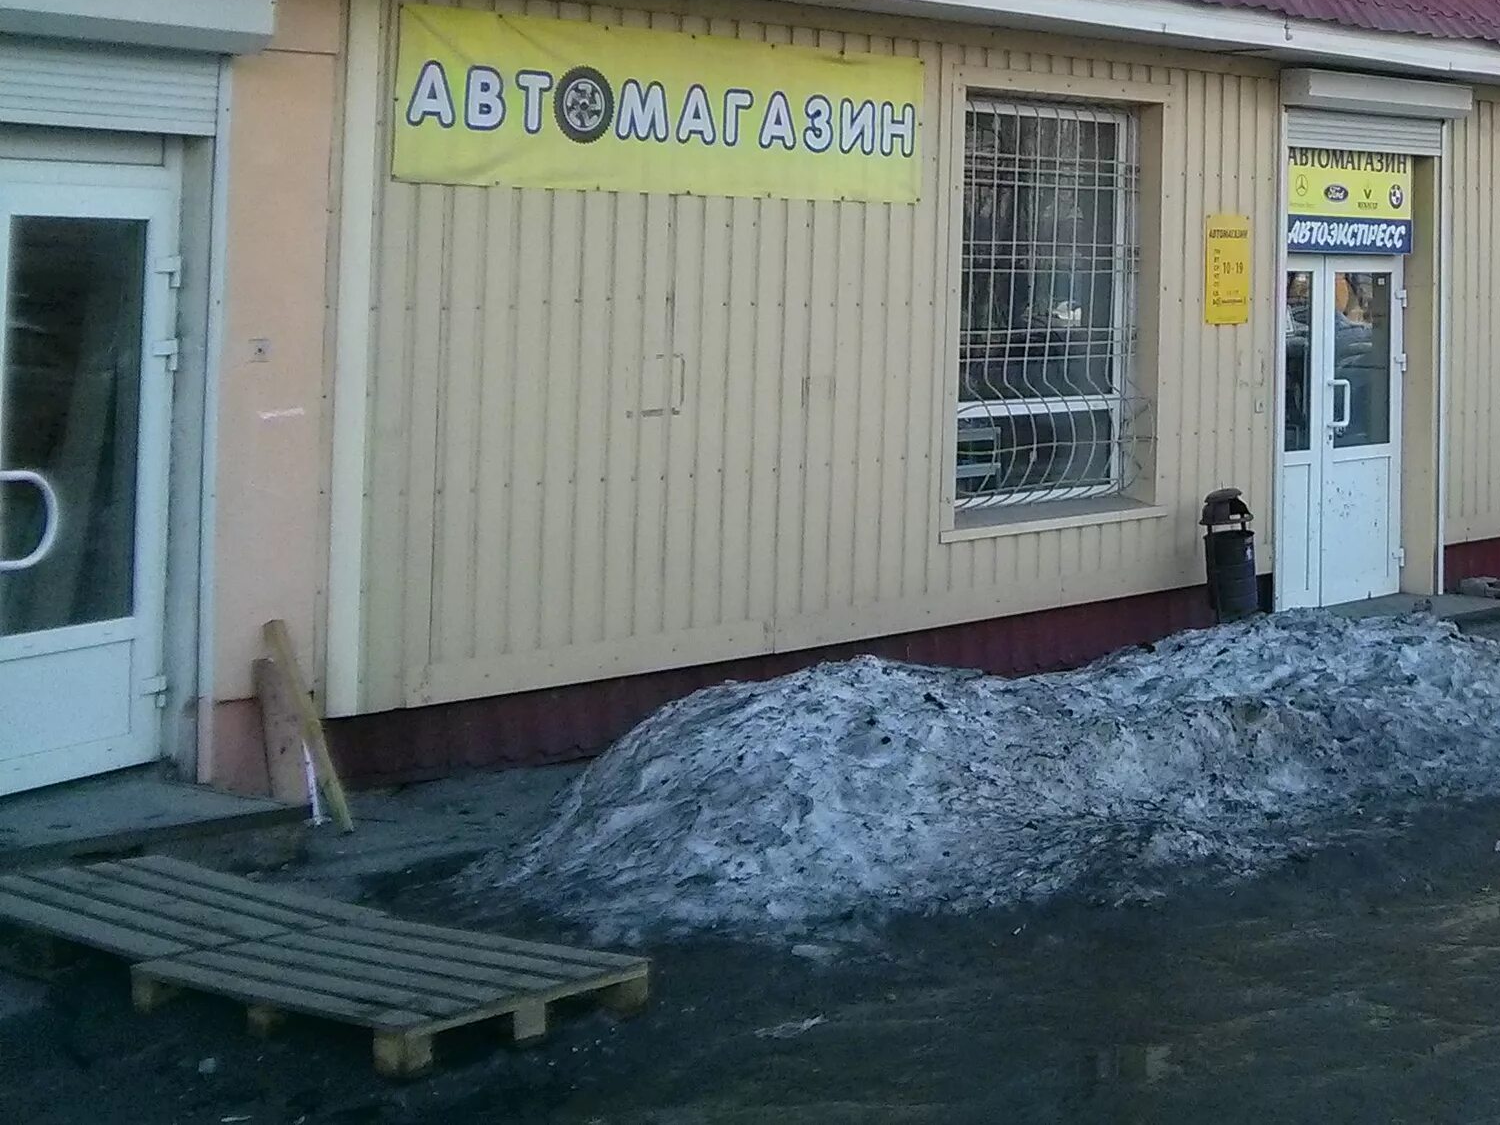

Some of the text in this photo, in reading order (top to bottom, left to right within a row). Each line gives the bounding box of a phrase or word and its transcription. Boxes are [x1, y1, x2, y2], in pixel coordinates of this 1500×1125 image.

[406, 59, 917, 159] АВТОМАГАЗИН
[1288, 147, 1408, 174] АВТОМАГАЗИН
[1209, 229, 1248, 239] АВТОМАГАЗИН
[1288, 220, 1406, 249] АВТОЭКСПРЕСС
